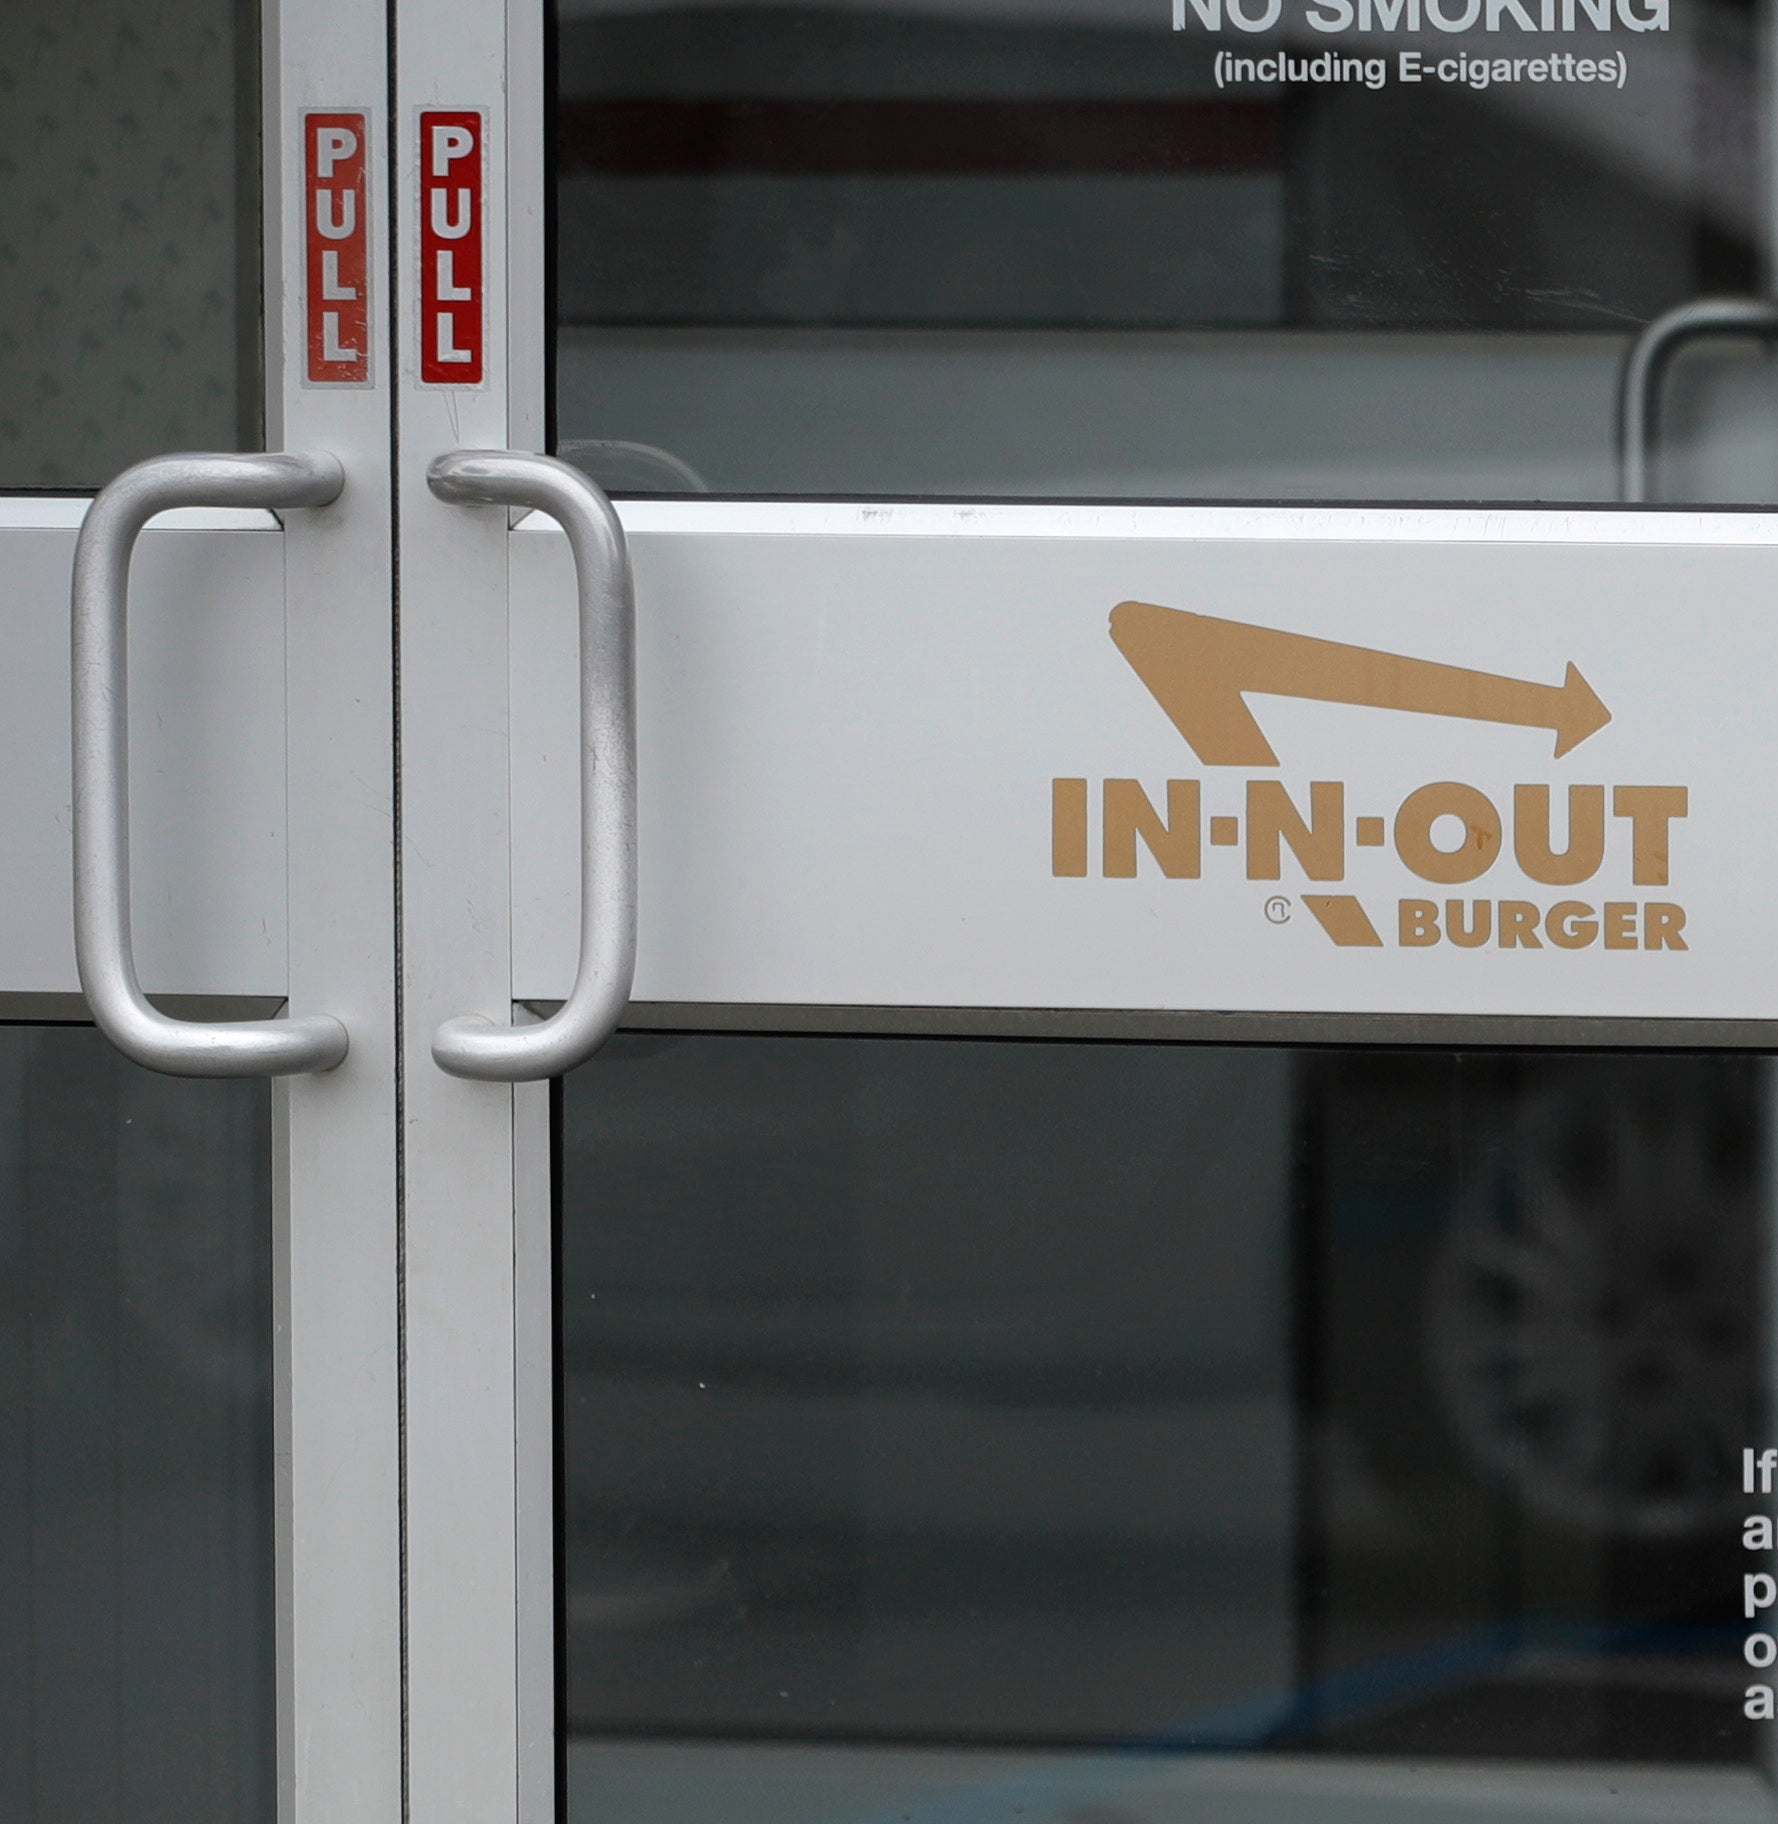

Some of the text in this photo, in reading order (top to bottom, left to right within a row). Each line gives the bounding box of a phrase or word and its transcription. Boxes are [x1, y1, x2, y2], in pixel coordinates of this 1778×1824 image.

[1214, 50, 1628, 90] (including E-cigarettes)
[316, 126, 358, 362] PULL
[431, 125, 474, 363] PULL
[1398, 898, 1689, 951] BURGER
[1742, 1447, 1778, 1494] If
